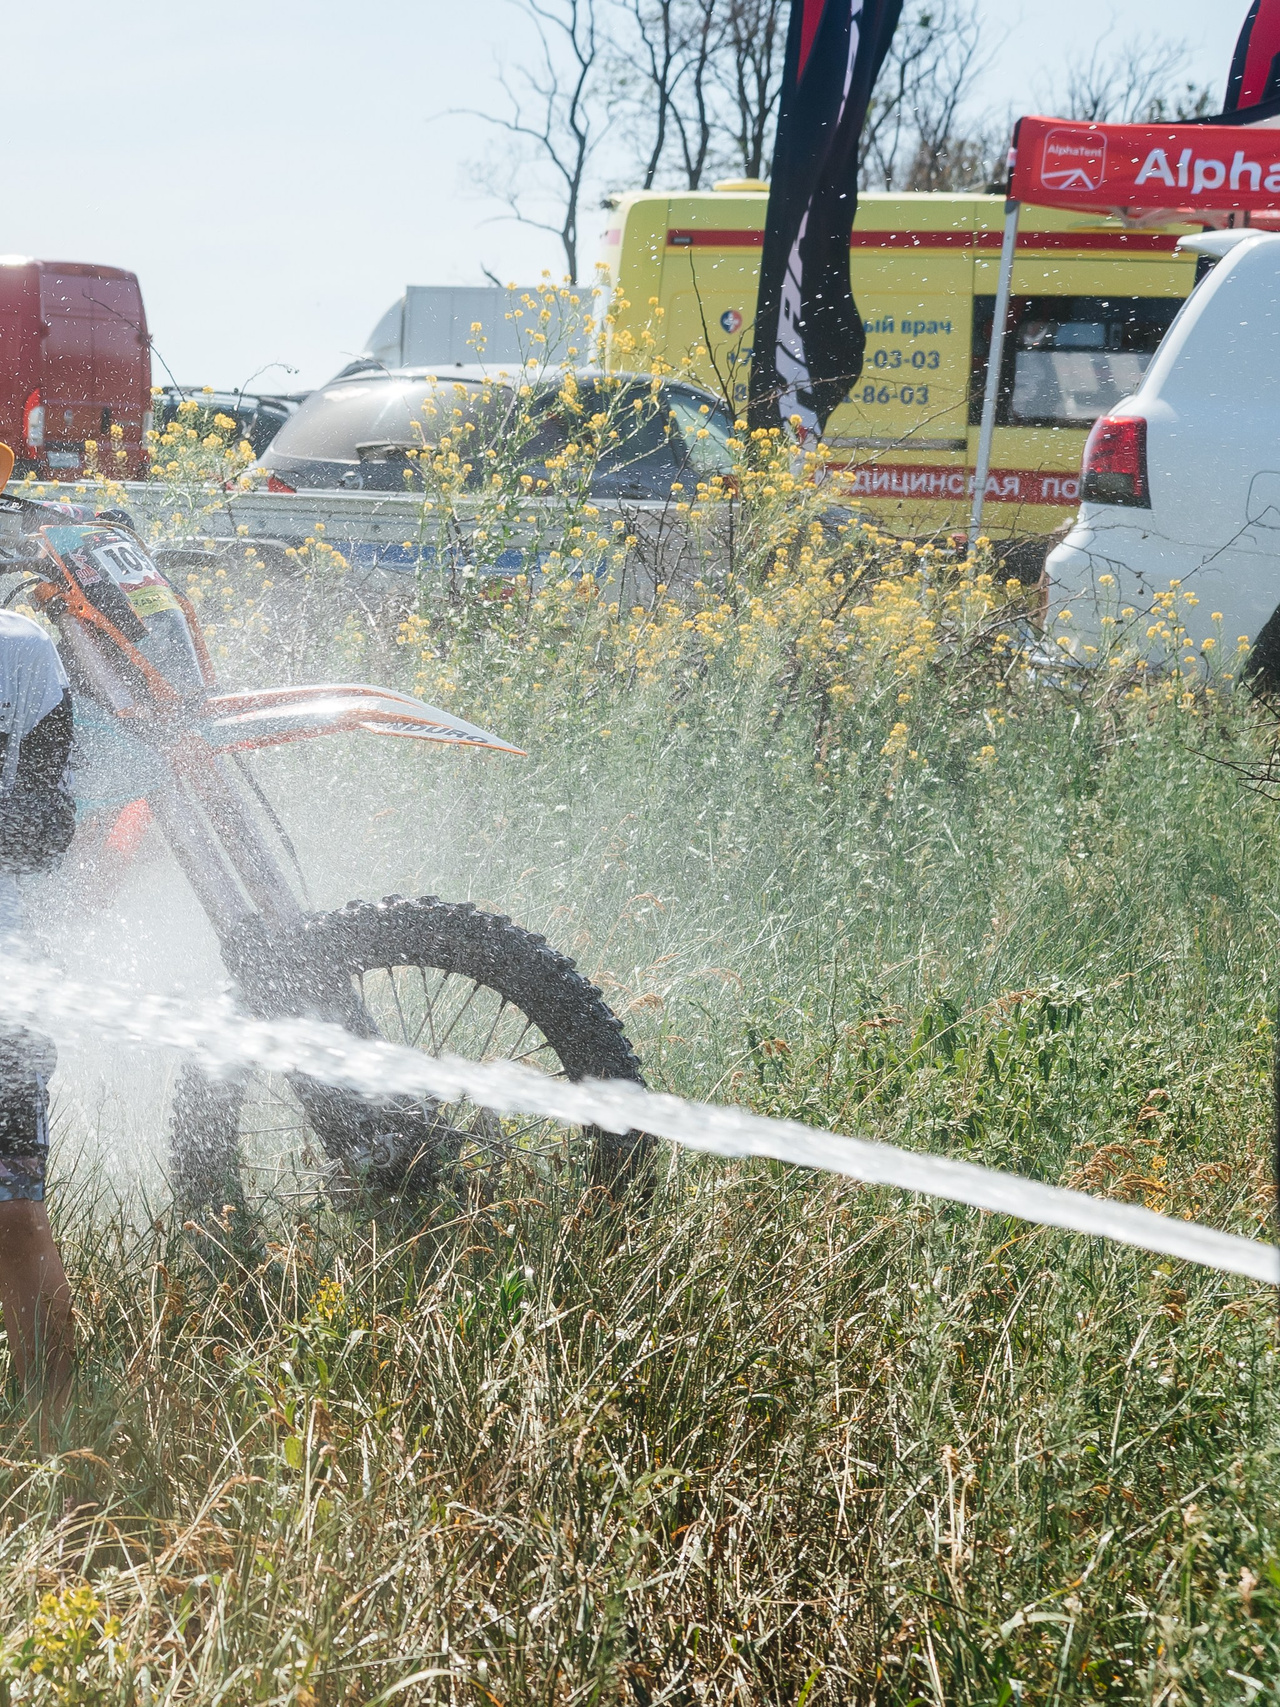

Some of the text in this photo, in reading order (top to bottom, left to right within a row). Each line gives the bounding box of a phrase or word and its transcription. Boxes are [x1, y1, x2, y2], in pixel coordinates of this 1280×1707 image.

[1048, 144, 1102, 157] AlphaTent
[901, 319, 952, 337] врач
[864, 350, 940, 369] -03-03
[815, 468, 1020, 497] ДИЦИНСАЯ
[375, 722, 489, 744] NDURO
